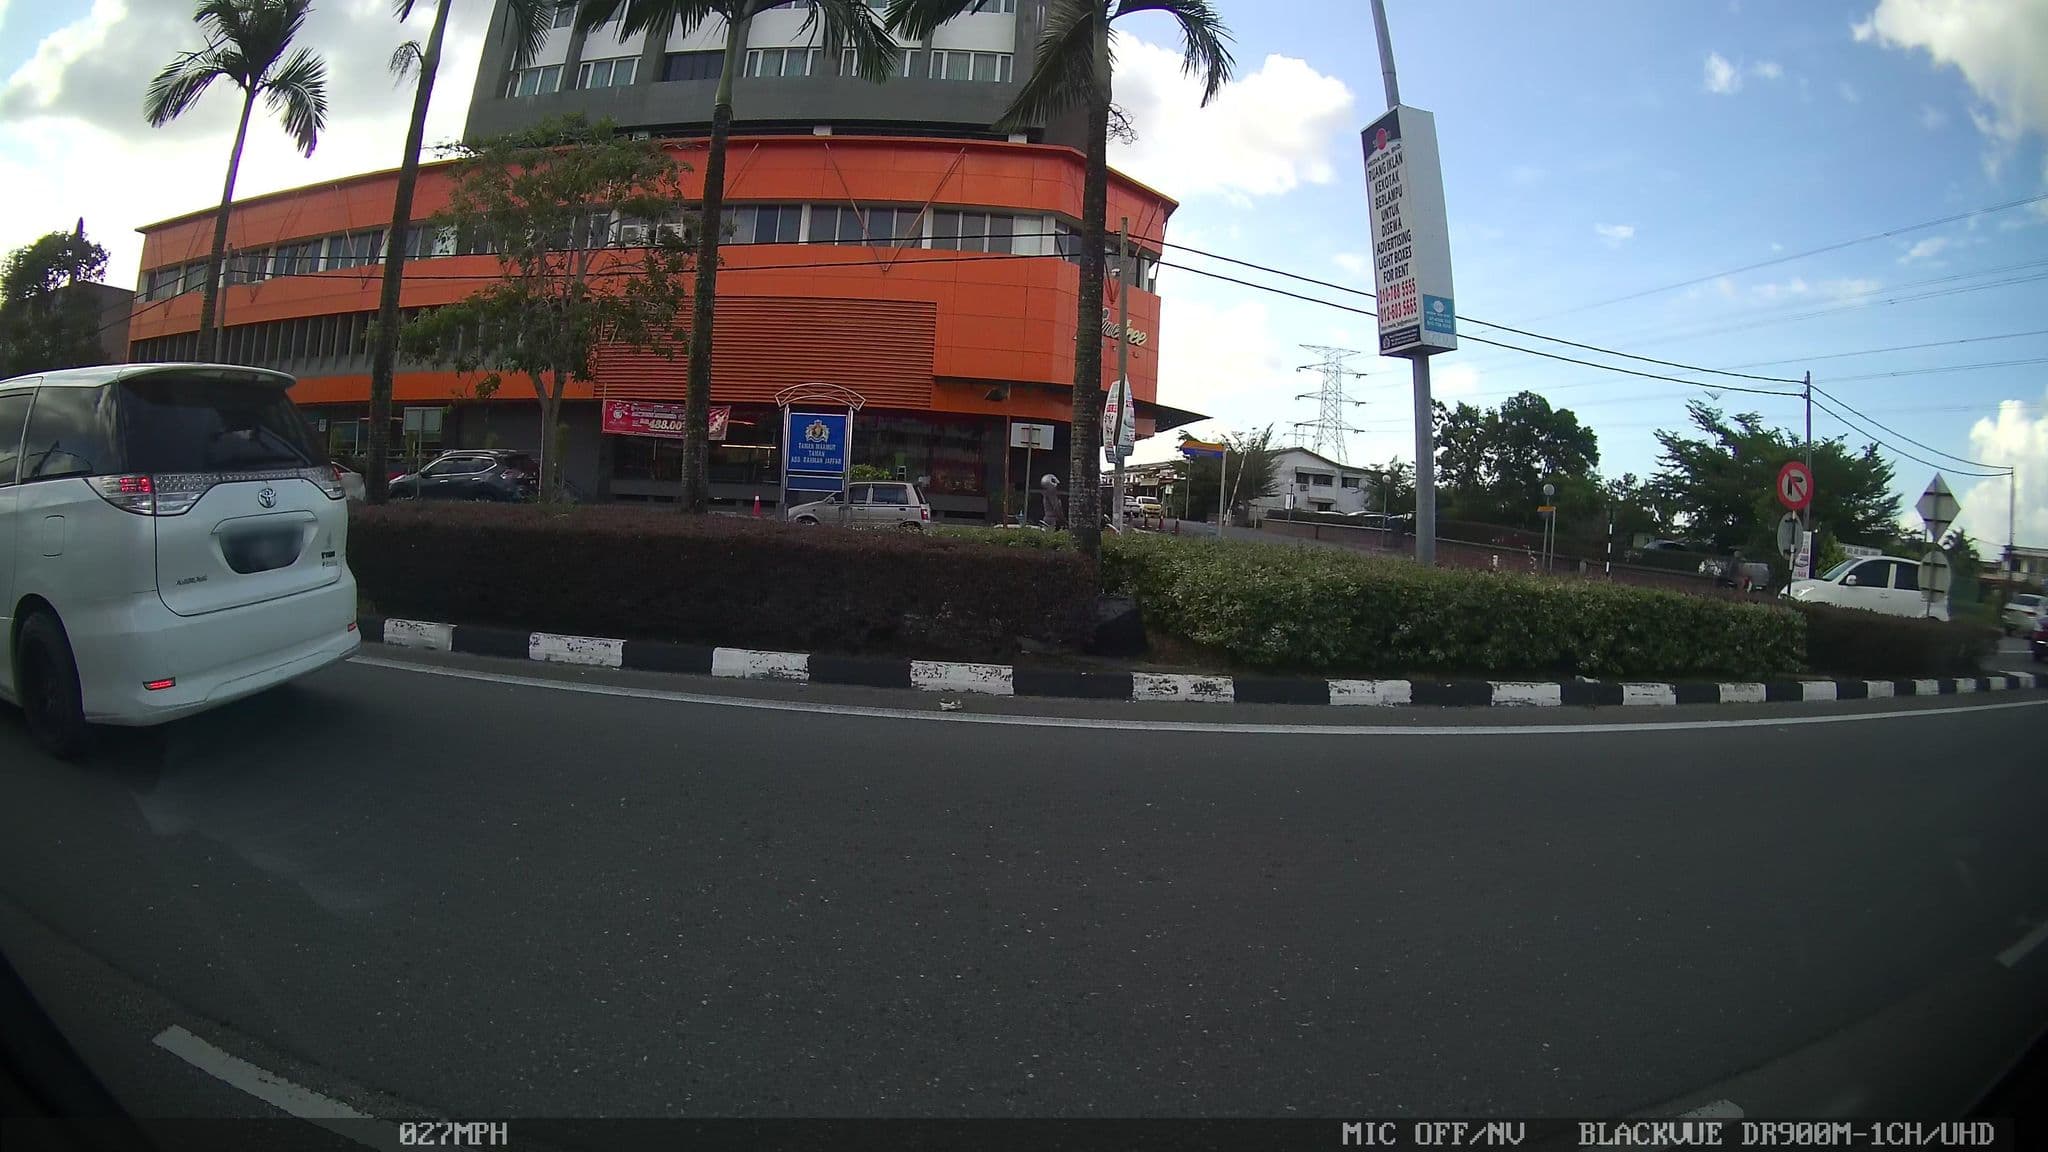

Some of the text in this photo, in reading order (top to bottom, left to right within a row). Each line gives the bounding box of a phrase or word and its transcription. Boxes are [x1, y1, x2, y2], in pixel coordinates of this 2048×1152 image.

[1386, 151, 1404, 173] IKLAN
[1375, 169, 1401, 194] KEKOTAK
[1375, 183, 1403, 210] BERLAMPU
[1381, 202, 1401, 222] UNTUK
[1381, 216, 1403, 237] DISEWA
[1376, 229, 1412, 255] ADVERTISING
[1378, 245, 1412, 270] LIGHT BOXES
[1383, 262, 1409, 284] FOR RENT
